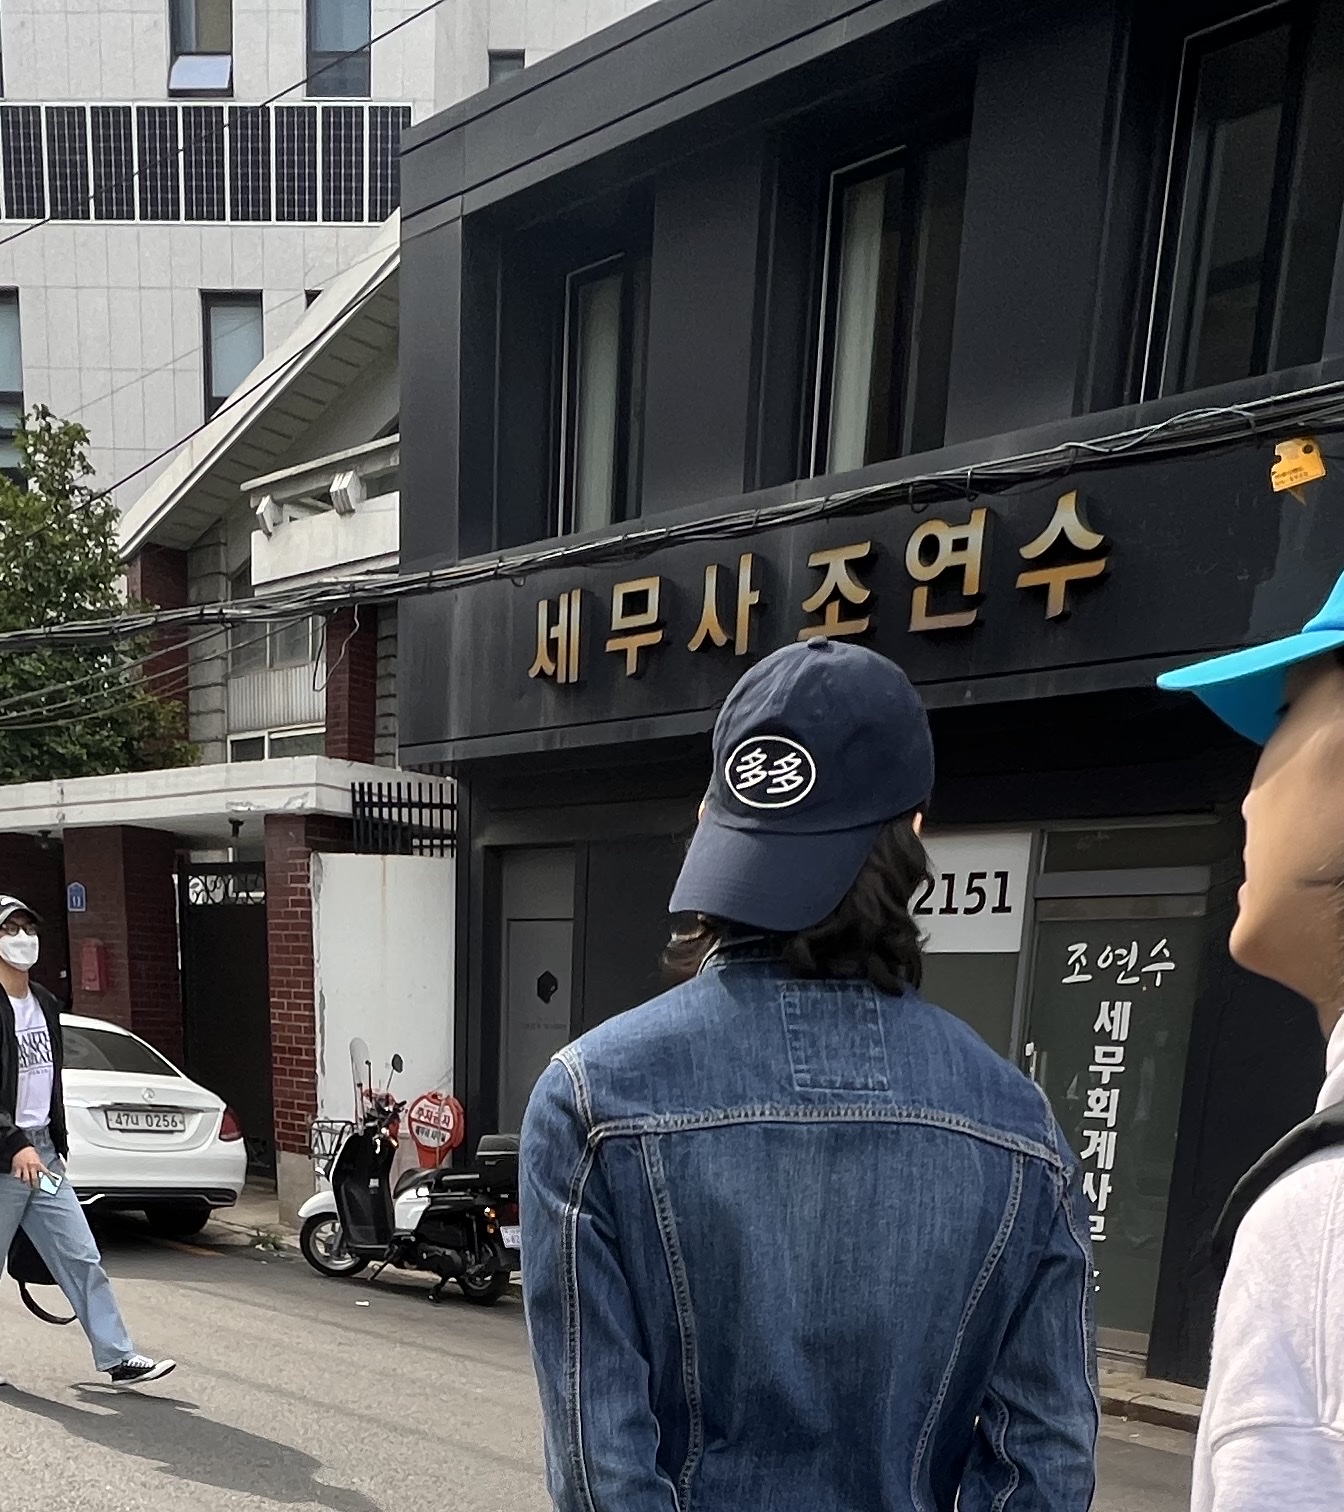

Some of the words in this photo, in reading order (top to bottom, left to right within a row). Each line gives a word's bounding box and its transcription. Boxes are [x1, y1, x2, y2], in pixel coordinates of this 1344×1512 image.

[527, 552, 762, 684] 세무사
[795, 490, 1107, 641] 조연수
[1061, 938, 1177, 987] 조연수
[145, 1113, 178, 1128] 0256
